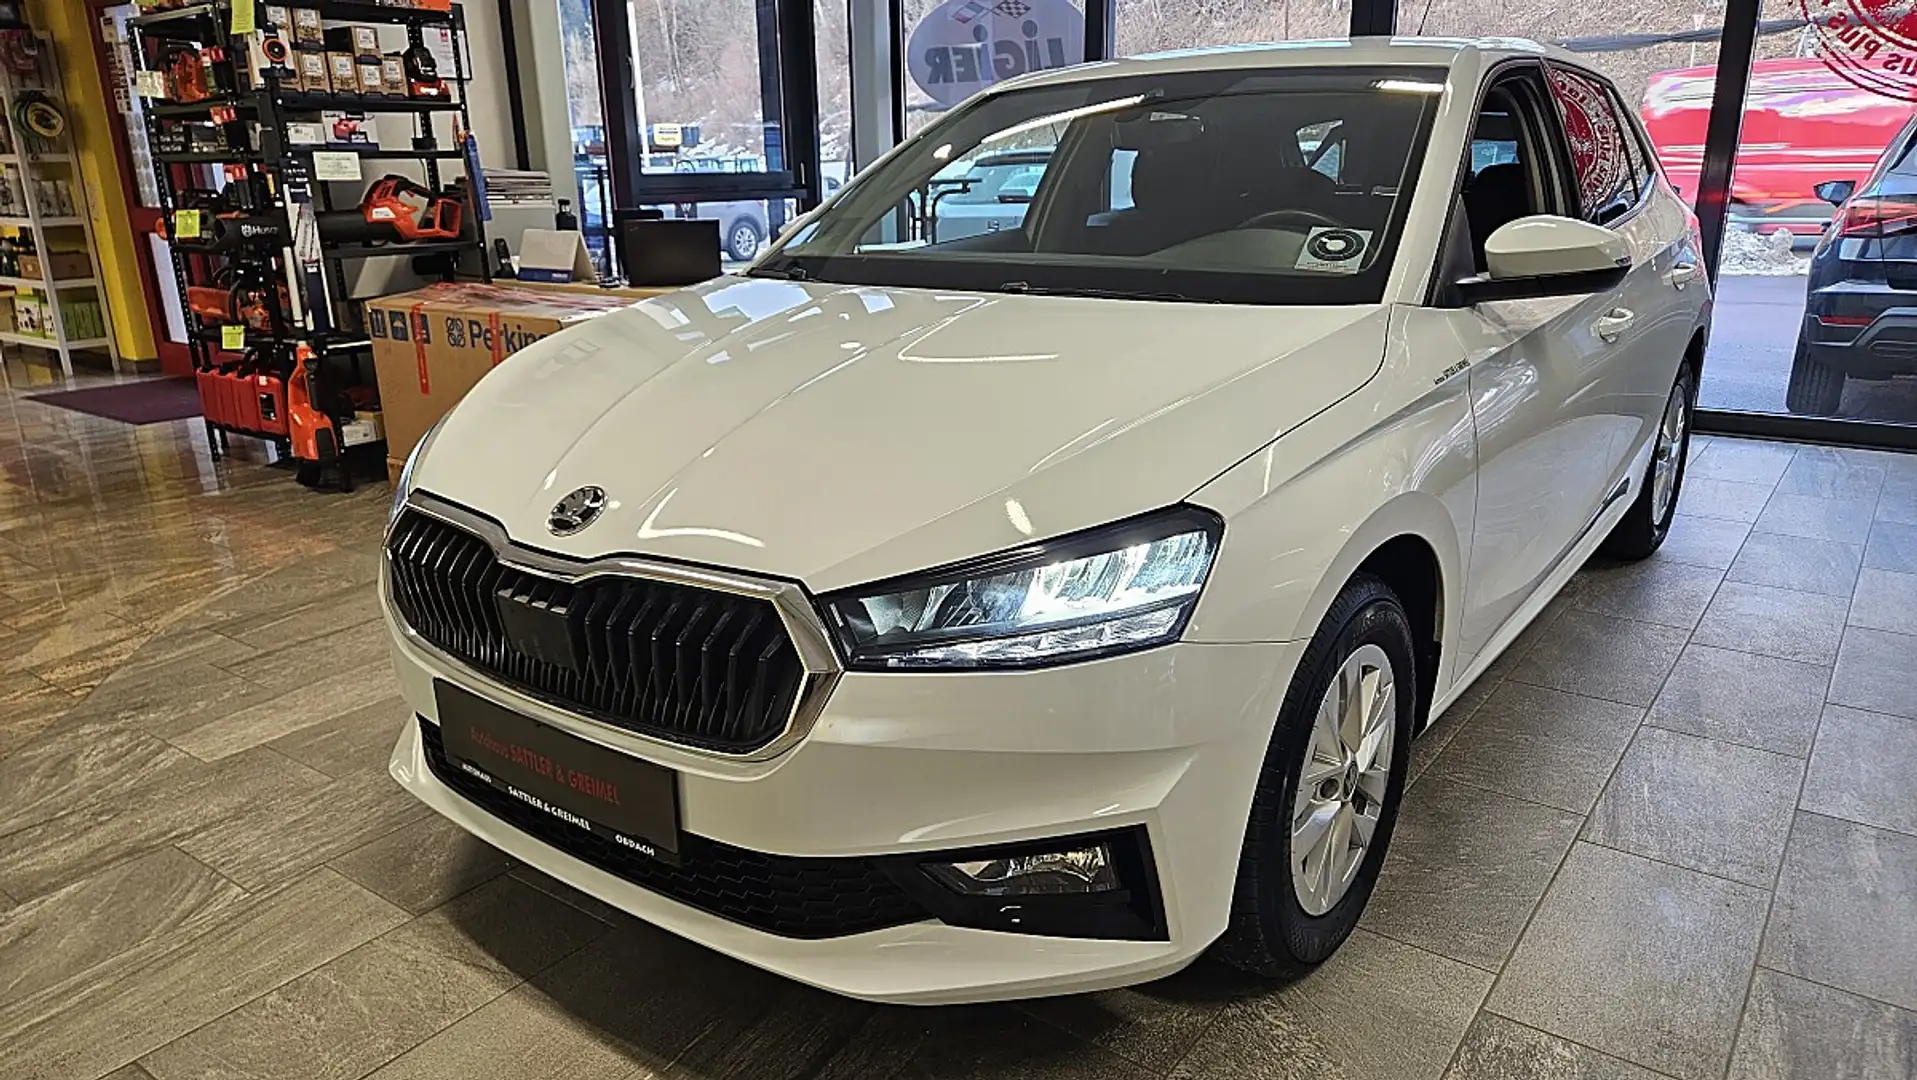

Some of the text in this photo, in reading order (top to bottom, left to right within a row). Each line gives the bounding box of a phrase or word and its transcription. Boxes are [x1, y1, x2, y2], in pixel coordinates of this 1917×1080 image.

[468, 319, 548, 352] Pekin
[510, 744, 553, 777] SATTLER
[556, 765, 566, 784] &
[567, 770, 620, 806] GREIMEL
[508, 786, 543, 813] SATTLER
[551, 806, 591, 831] GREIMEL
[615, 834, 656, 856] OBDACH
